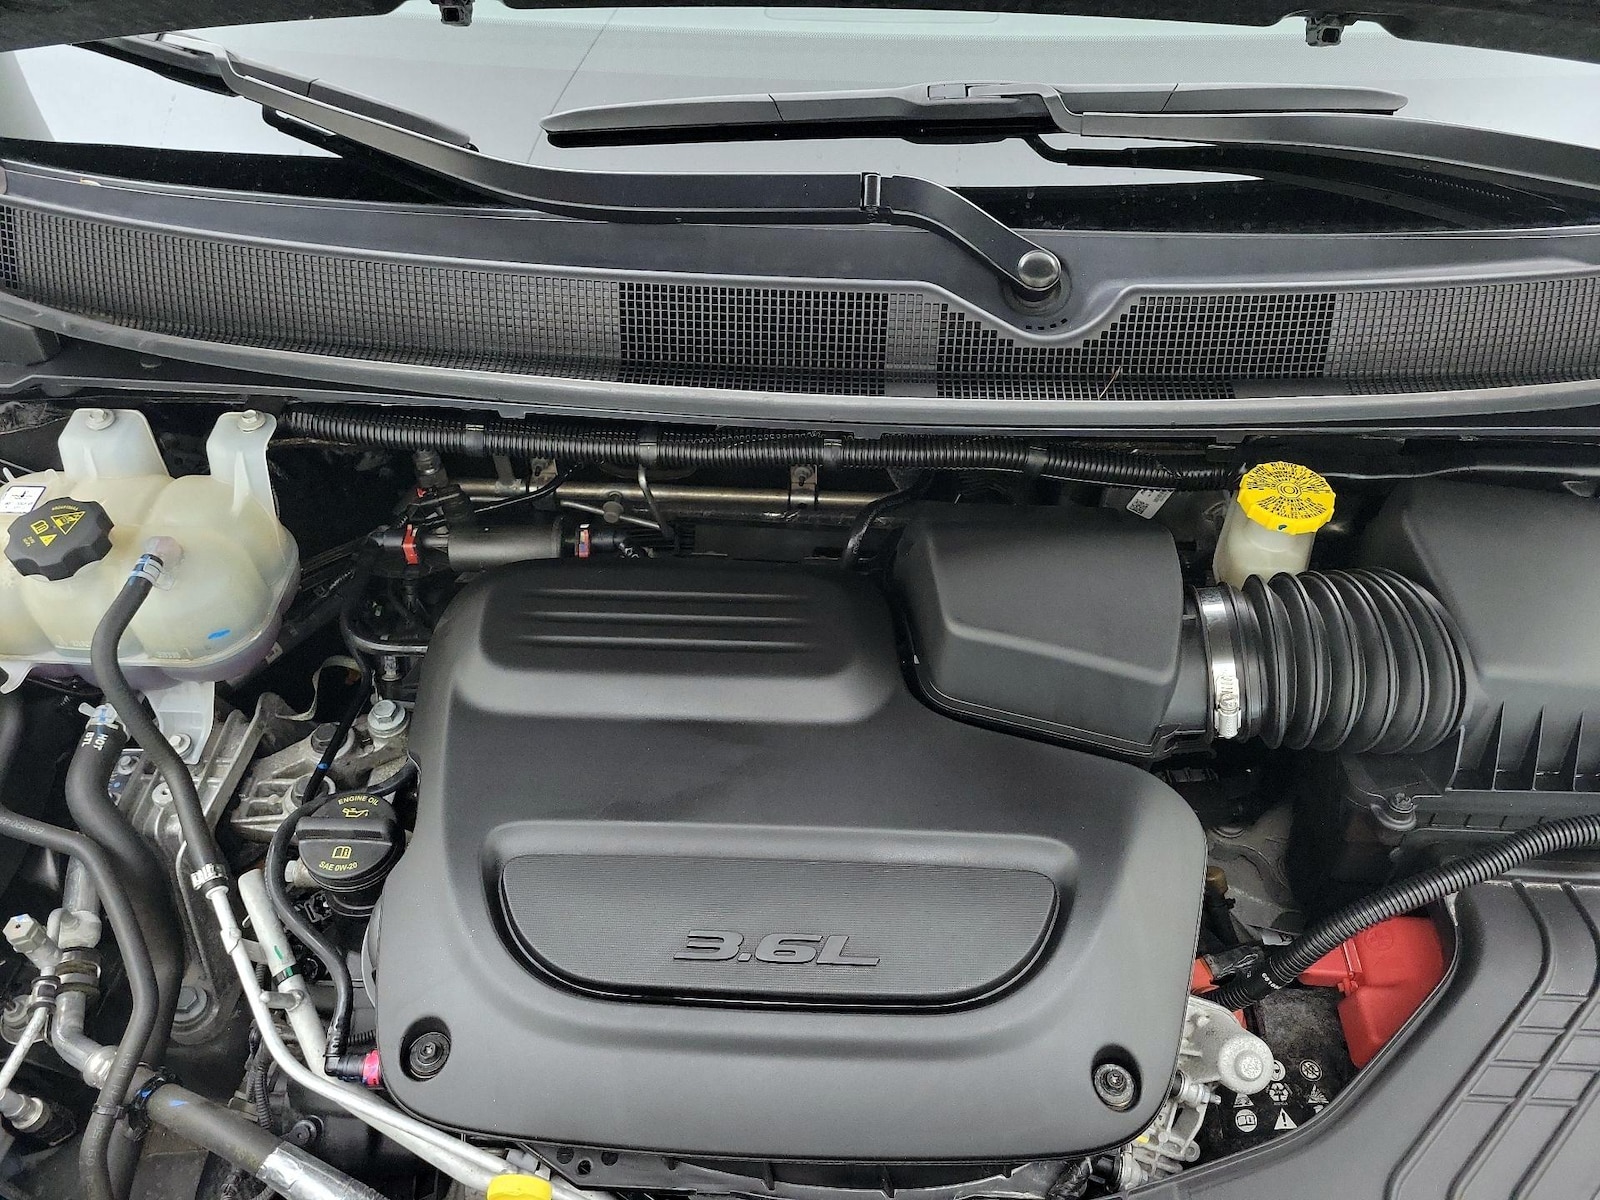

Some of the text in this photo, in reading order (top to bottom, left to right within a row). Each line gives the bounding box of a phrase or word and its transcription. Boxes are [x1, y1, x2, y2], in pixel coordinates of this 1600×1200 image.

[82, 731, 95, 747] BTL
[93, 733, 108, 750] HOT
[338, 795, 380, 806] ENGINE OIL
[319, 861, 358, 871] SAE 0W-20
[673, 929, 881, 966] 3.6L
